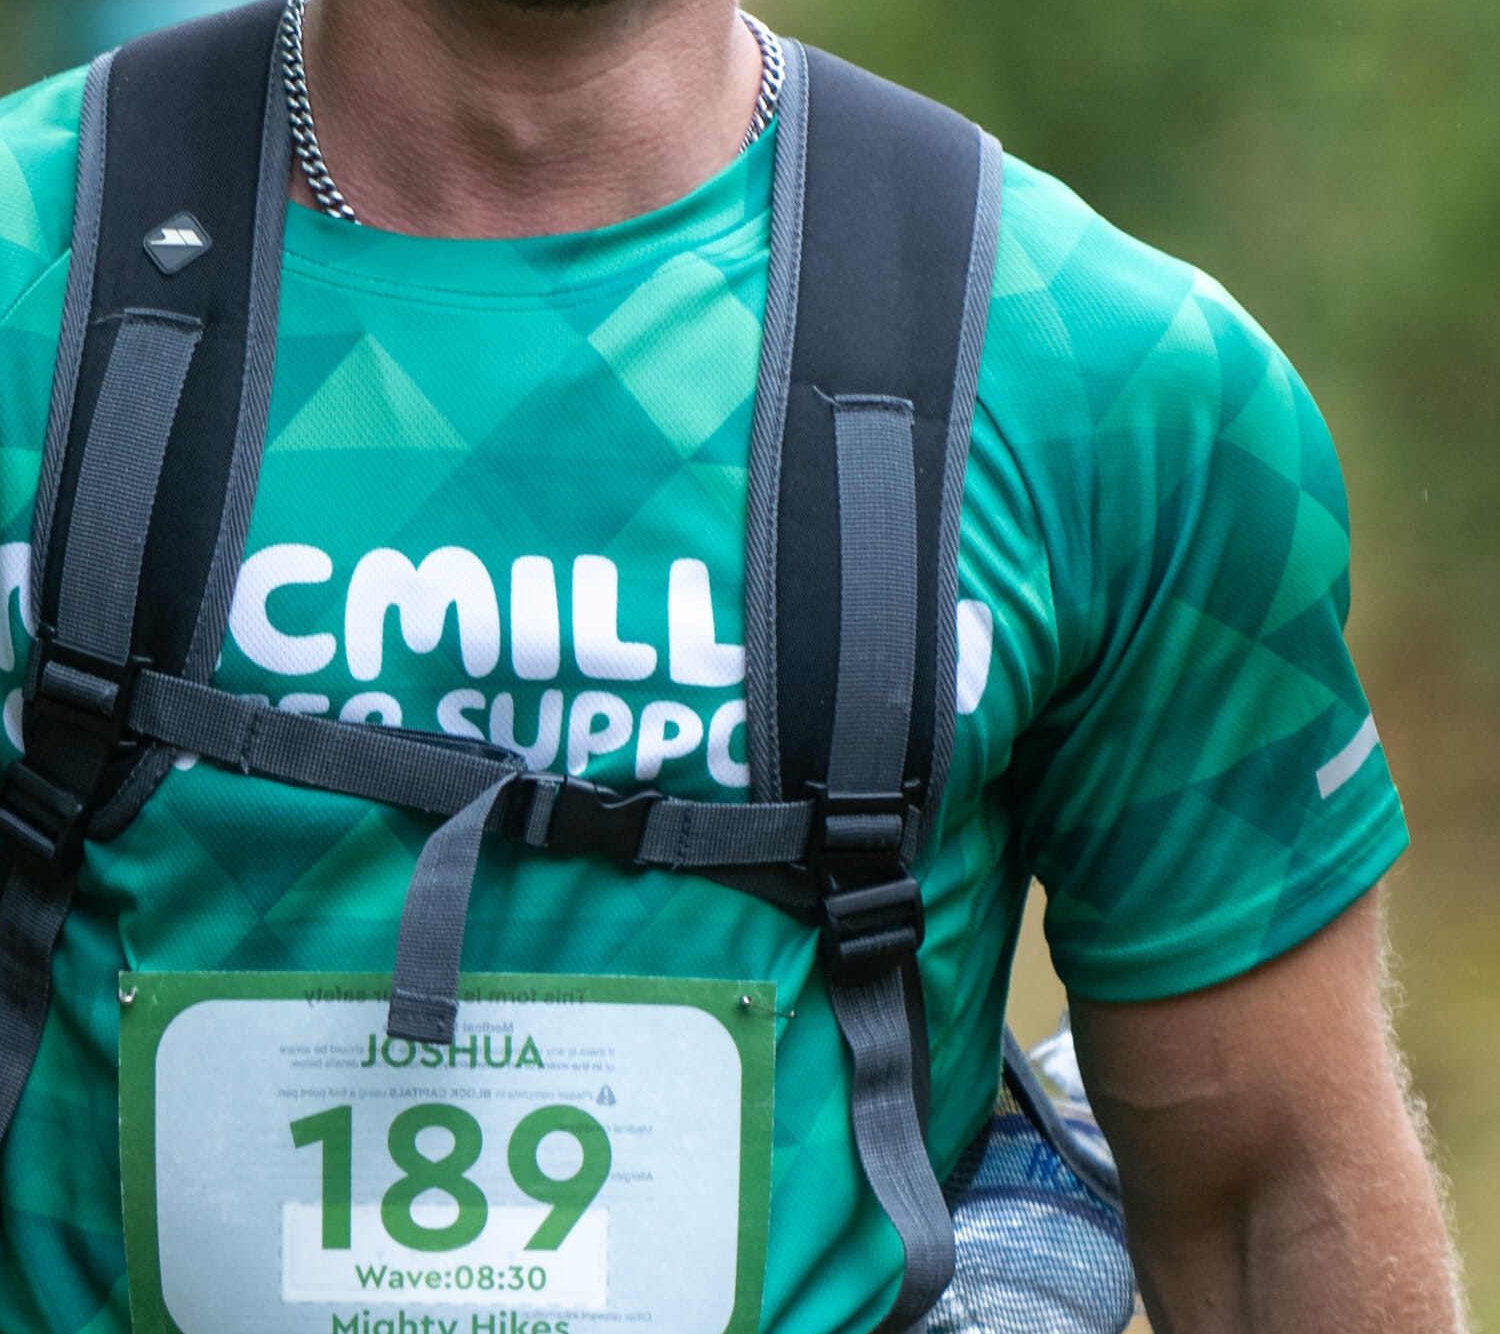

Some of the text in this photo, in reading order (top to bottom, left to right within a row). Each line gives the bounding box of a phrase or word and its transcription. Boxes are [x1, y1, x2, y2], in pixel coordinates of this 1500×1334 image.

[360, 1033, 546, 1069] JOSHUA
[289, 1103, 612, 1252] 189
[355, 1264, 547, 1291] Wave:08:30
